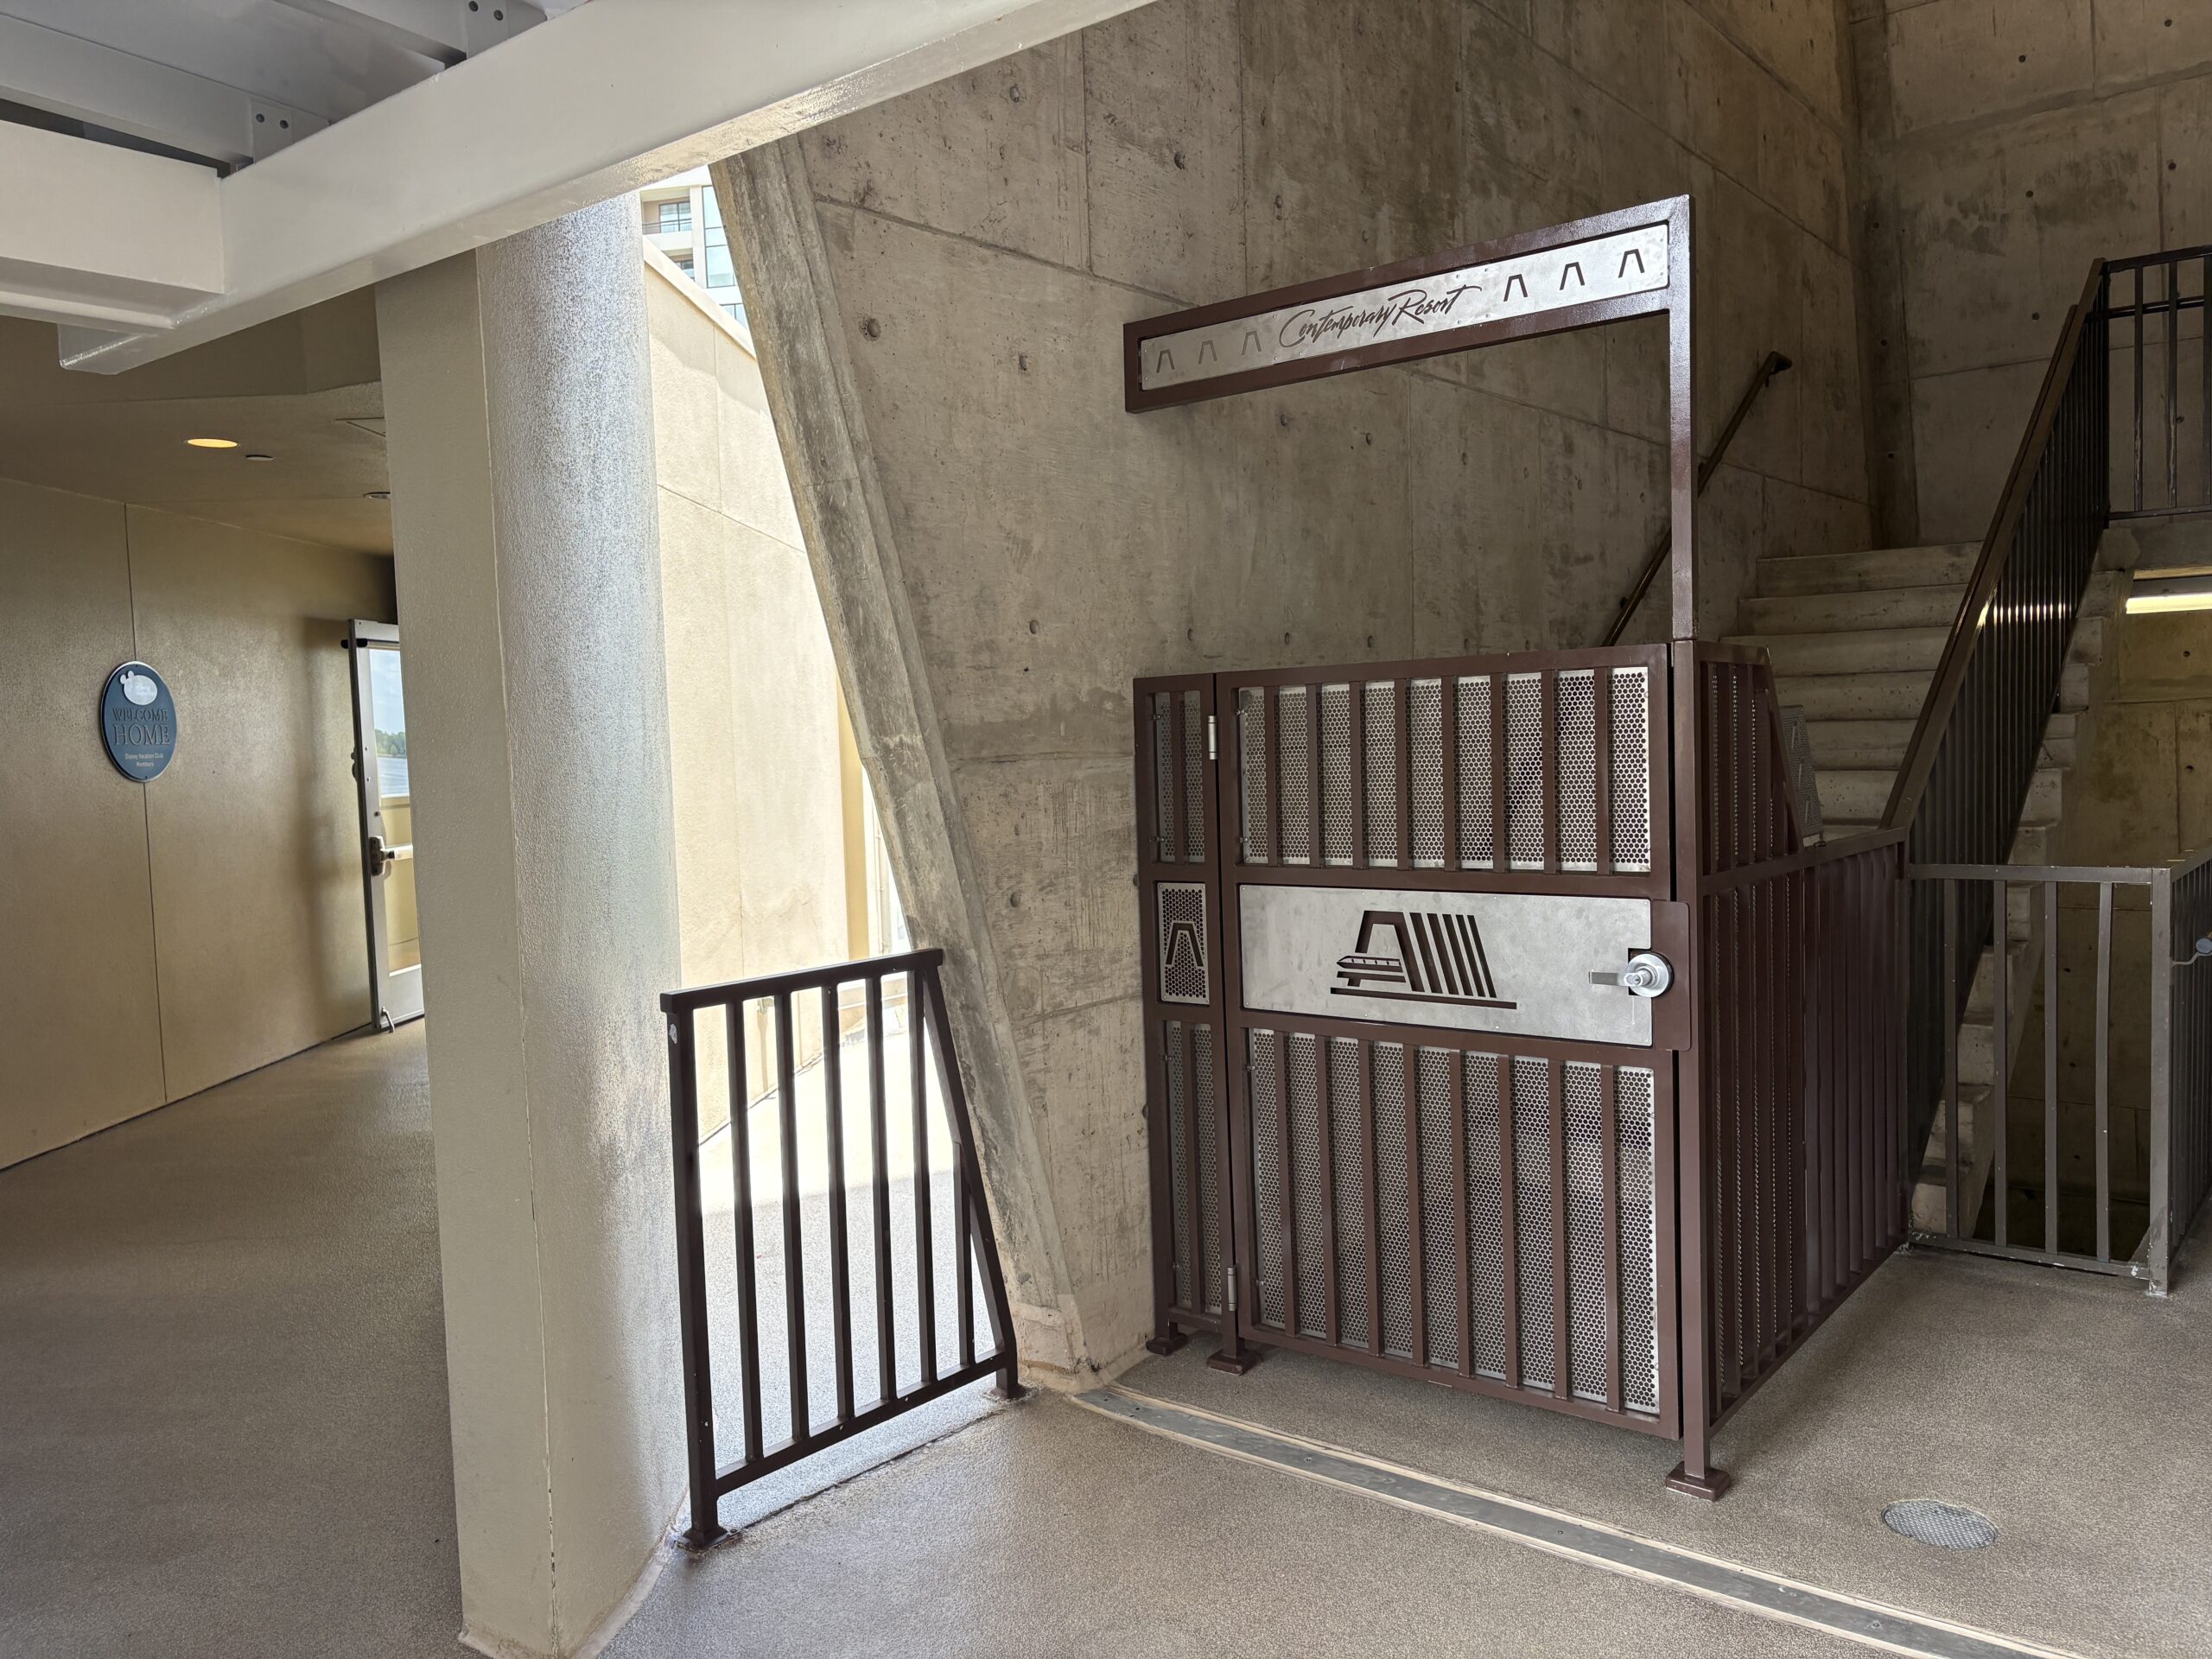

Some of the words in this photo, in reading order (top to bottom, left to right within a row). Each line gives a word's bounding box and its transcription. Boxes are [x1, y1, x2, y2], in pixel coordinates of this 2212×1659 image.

[1278, 303, 1396, 348] Contemporary
[1388, 283, 1483, 326] Resort
[112, 707, 168, 721] WELCOME
[113, 723, 170, 746] HOME
